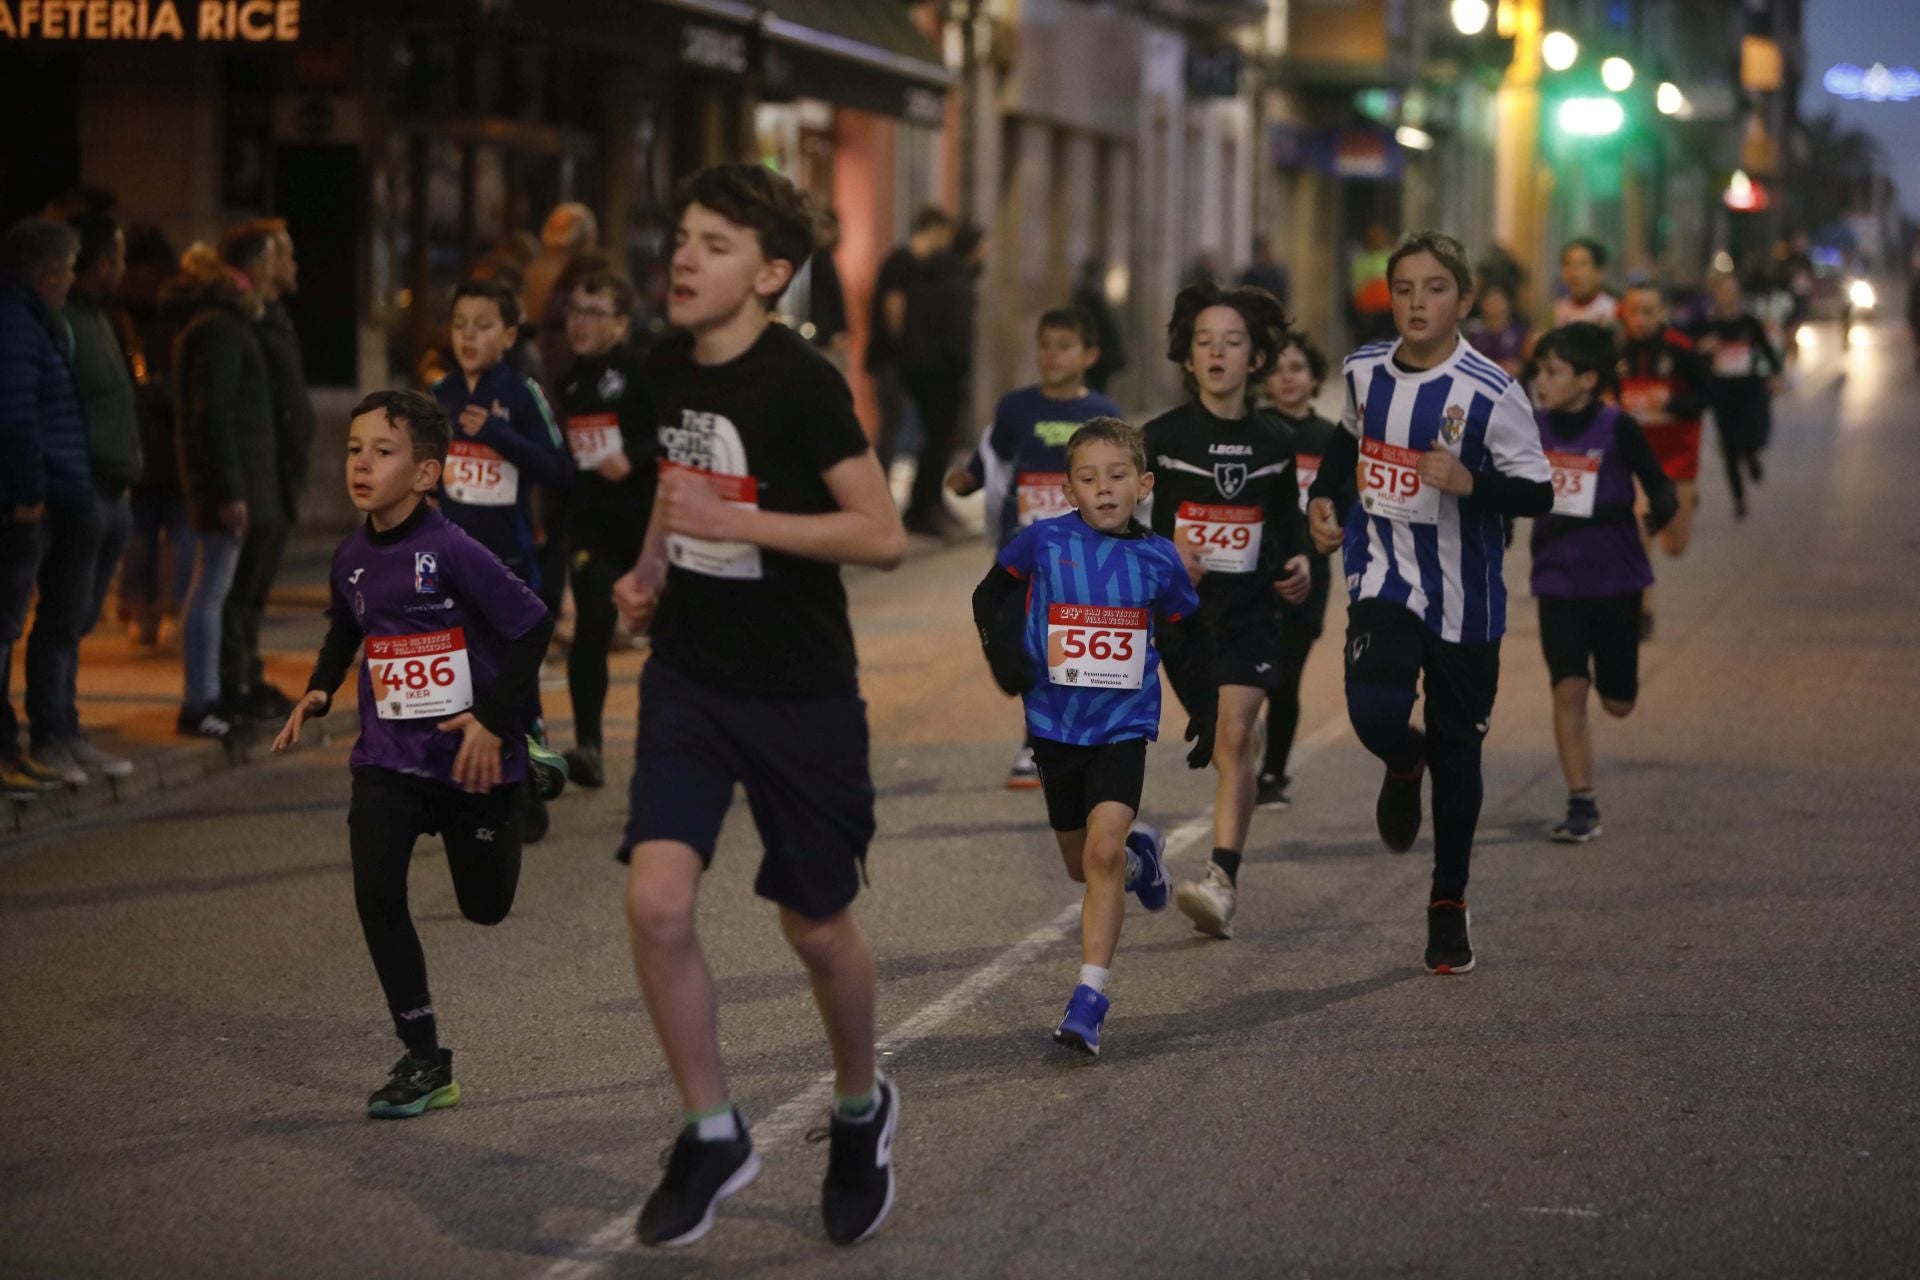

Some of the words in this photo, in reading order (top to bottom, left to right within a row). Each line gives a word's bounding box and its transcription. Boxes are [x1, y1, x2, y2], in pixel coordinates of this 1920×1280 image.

[198, 0, 299, 41] RICE
[1208, 444, 1253, 456] LEGEA
[458, 462, 502, 485] 515
[1367, 462, 1421, 497] 519
[1551, 469, 1583, 495] 93
[1187, 524, 1251, 550] 349
[1063, 629, 1133, 662] 563
[382, 657, 455, 691] 486
[406, 689, 431, 700] IKER
